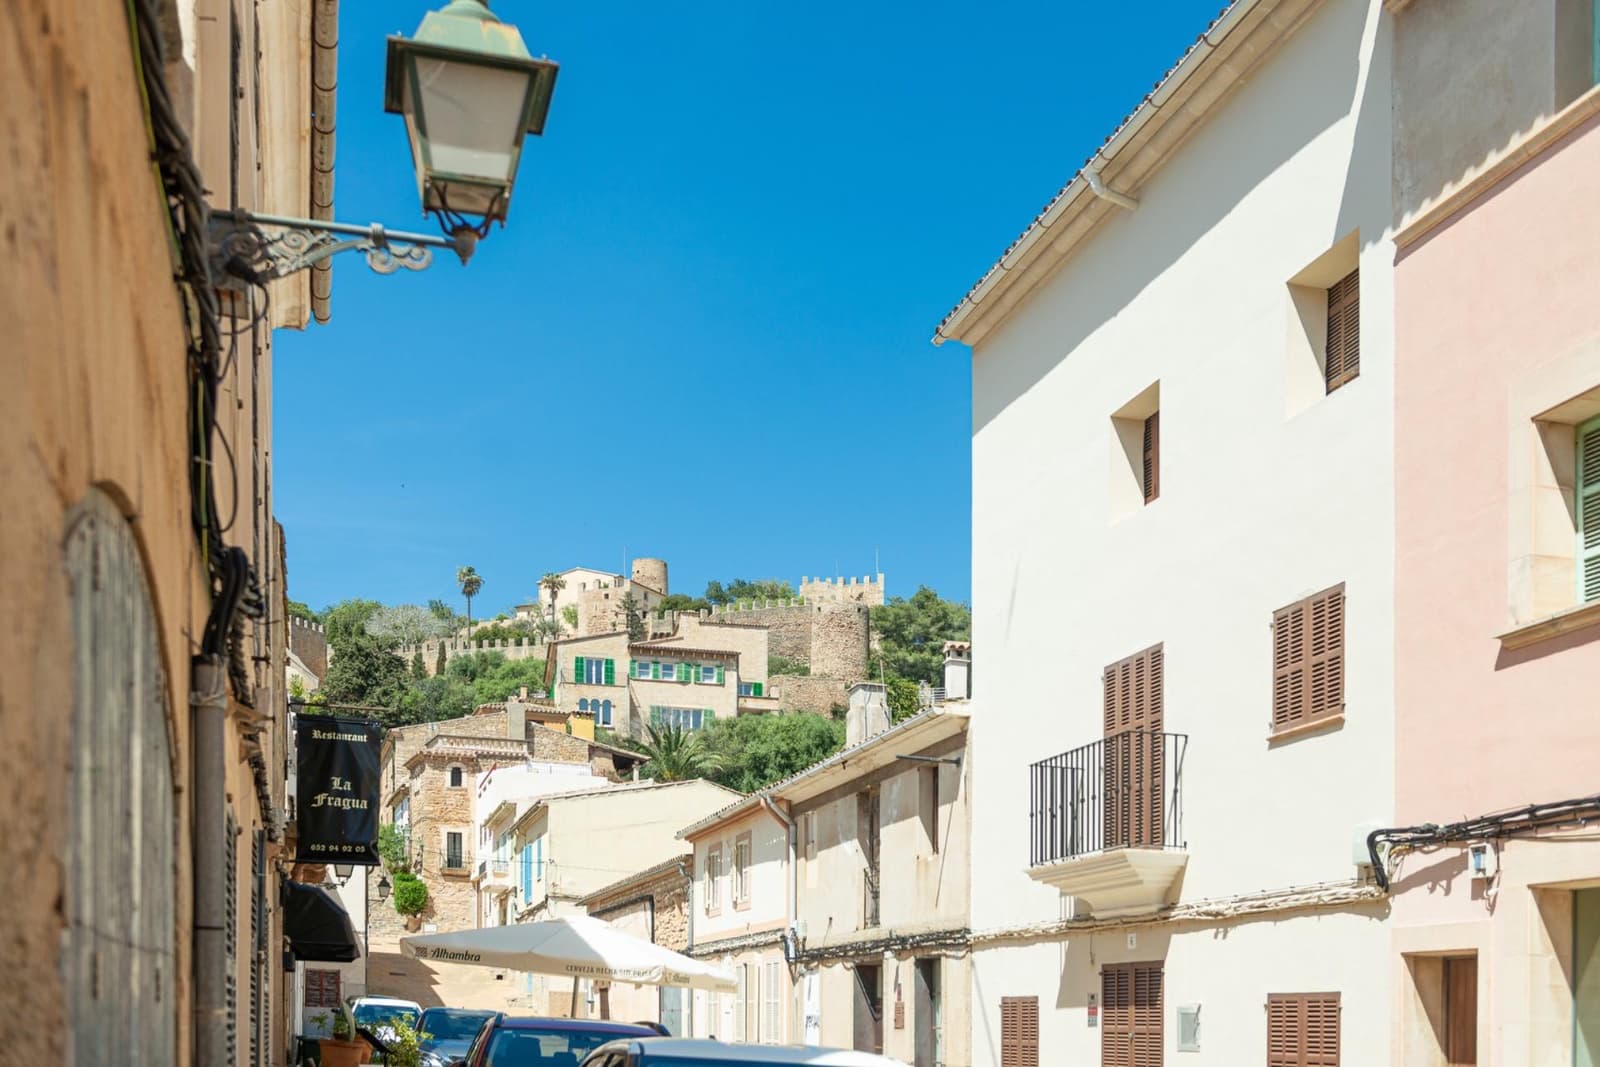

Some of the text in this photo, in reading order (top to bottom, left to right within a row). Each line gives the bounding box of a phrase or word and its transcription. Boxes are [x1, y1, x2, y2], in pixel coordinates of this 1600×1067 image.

[312, 729, 368, 743] Restaurant
[331, 776, 352, 791] La
[311, 793, 368, 810] Fragua
[431, 947, 481, 961] Alhambra
